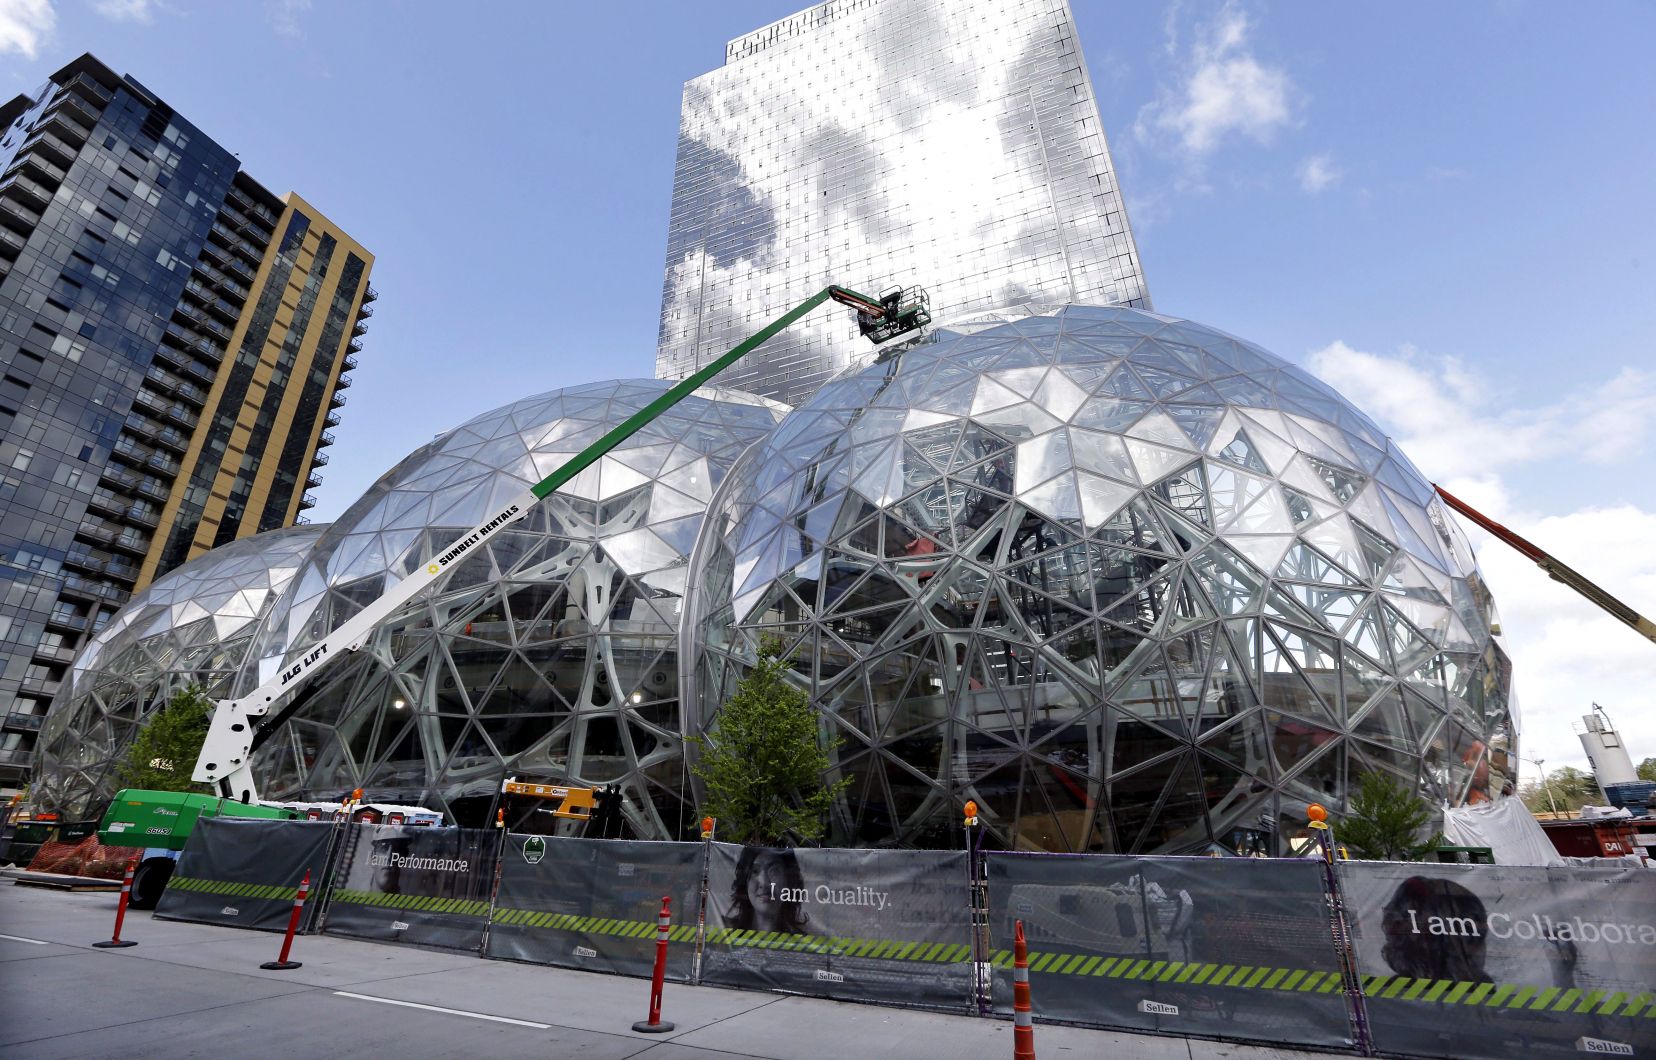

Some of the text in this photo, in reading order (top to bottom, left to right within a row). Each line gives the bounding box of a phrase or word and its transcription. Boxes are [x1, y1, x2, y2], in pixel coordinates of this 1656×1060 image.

[438, 505, 519, 566] SUNBELT RENTALS
[281, 643, 328, 686] JLG LIFT
[371, 854, 389, 866] am
[390, 852, 469, 872] Performance.
[770, 882, 892, 911] I am Quality.
[1407, 909, 1656, 945] I am Collabora
[819, 972, 842, 981] Sellen
[1146, 1003, 1177, 1014] Sellen
[1587, 1040, 1630, 1053] Sellen
